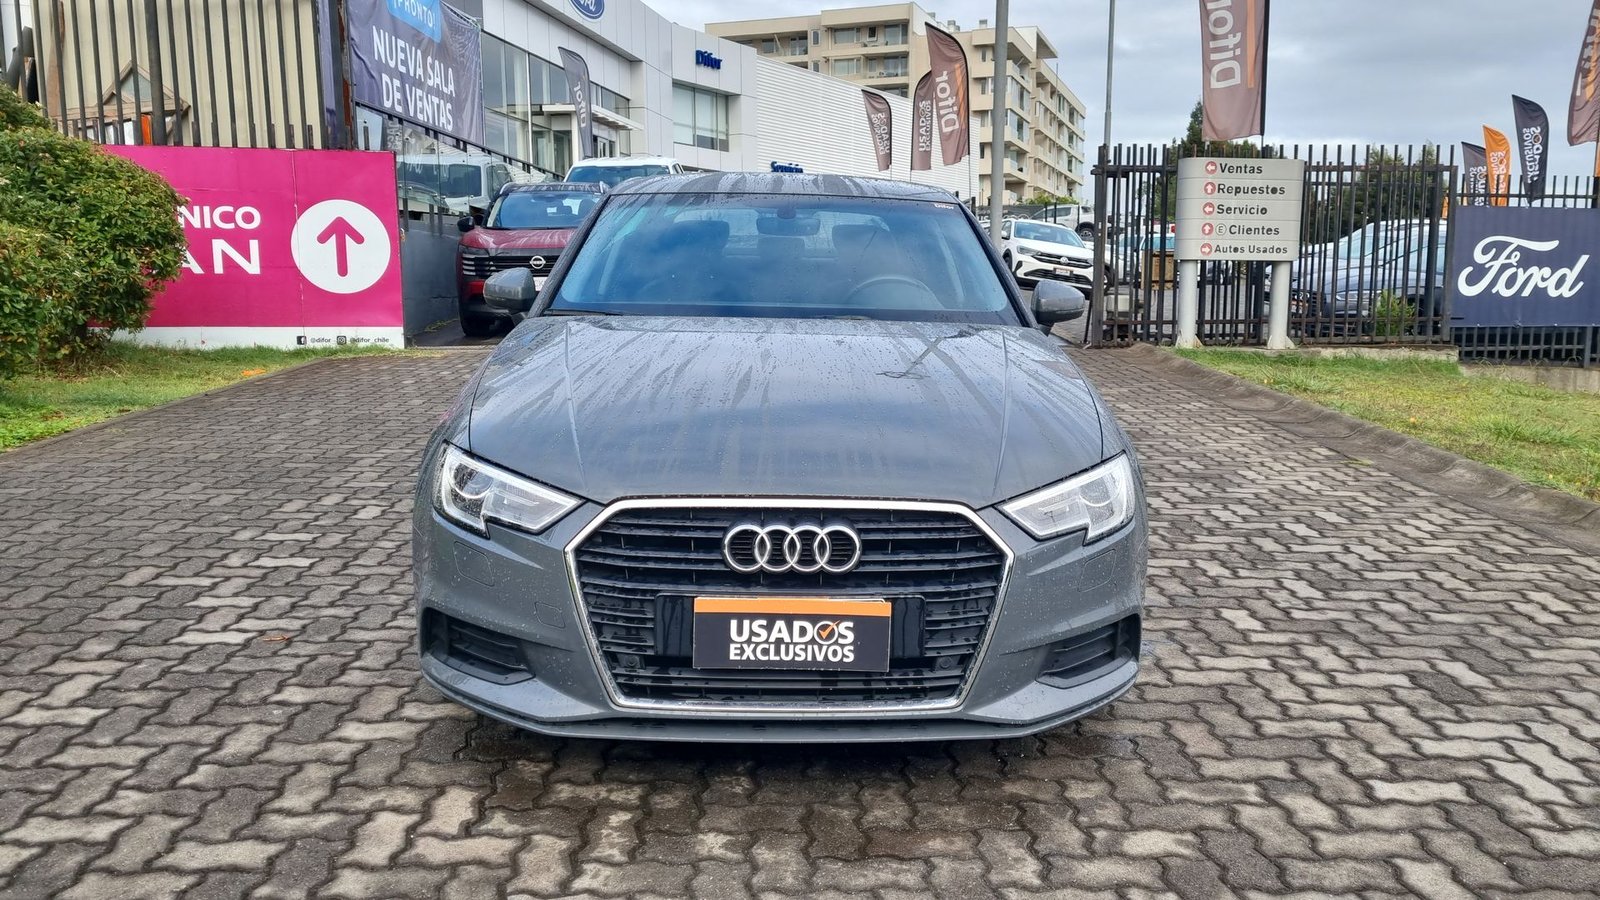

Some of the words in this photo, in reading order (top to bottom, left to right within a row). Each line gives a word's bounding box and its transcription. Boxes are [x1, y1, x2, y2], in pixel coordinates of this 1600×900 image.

[372, 25, 424, 82] NUEVA
[426, 56, 455, 97] SALA
[695, 49, 723, 70] Difor
[381, 73, 403, 113] DE
[405, 83, 454, 132] VENTAS
[1219, 162, 1263, 174] Ventas
[1217, 183, 1286, 196] Repuestos
[1216, 204, 1268, 215] Servicio
[1229, 224, 1280, 236] Clientes
[1214, 244, 1245, 254] Autos
[1248, 244, 1288, 254] Usados
[1457, 235, 1591, 298] Ford
[730, 618, 855, 645] USADOS
[729, 643, 855, 663] EXCLUSIVOS
